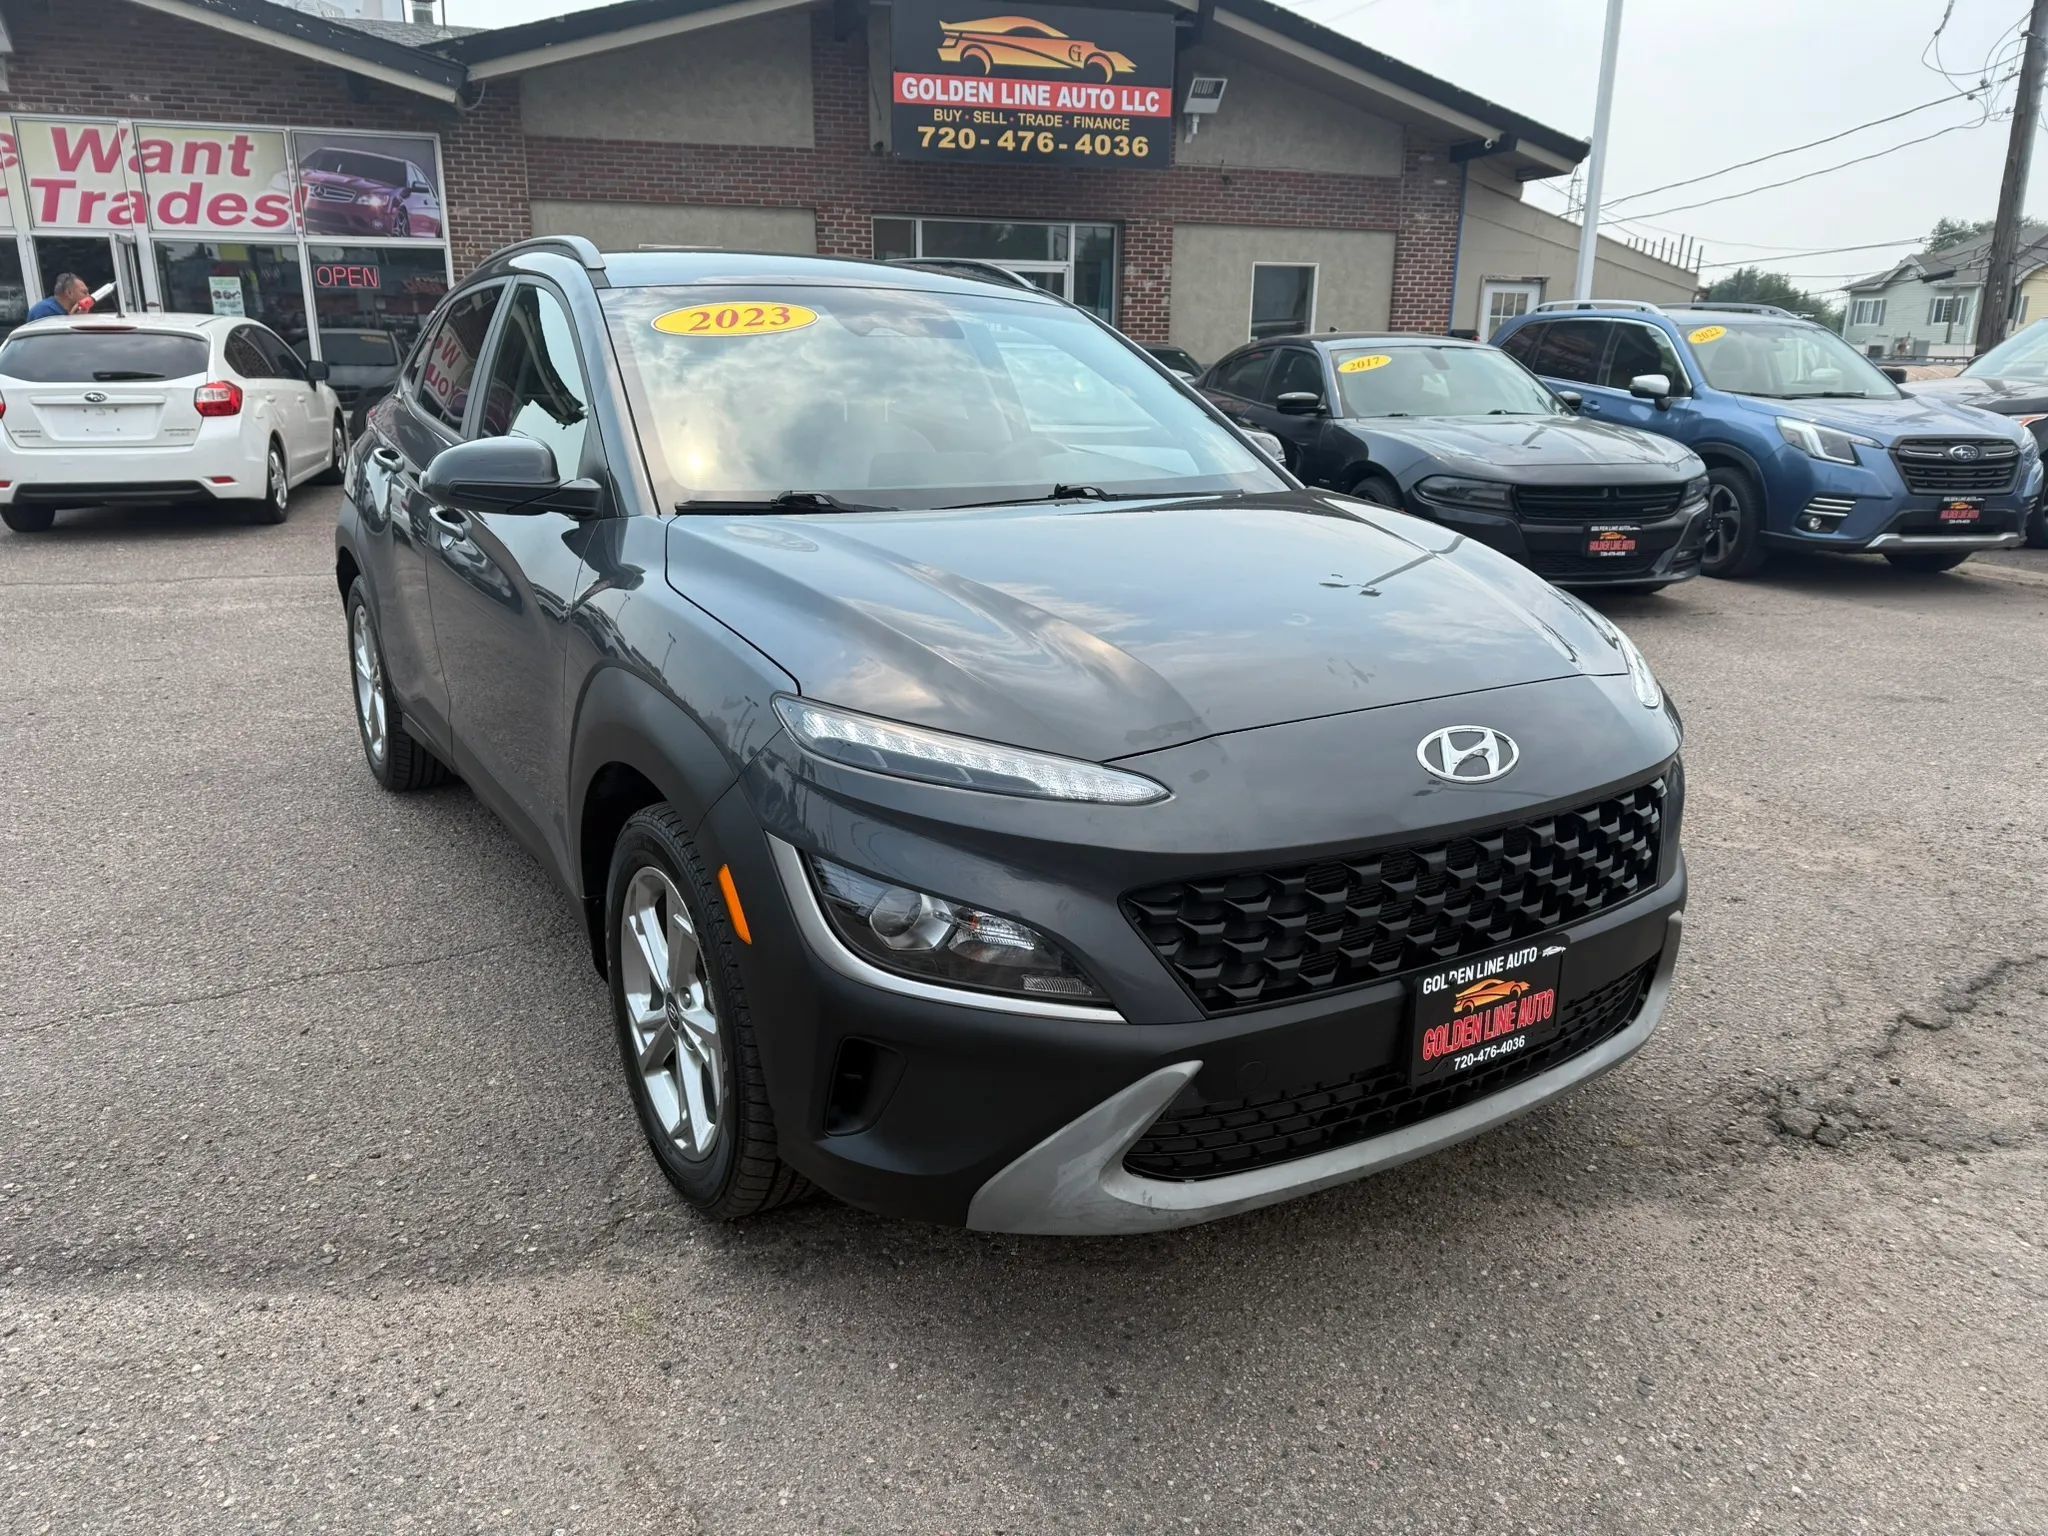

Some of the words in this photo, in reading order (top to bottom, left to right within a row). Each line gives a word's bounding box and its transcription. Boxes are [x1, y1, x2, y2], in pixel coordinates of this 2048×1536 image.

[1068, 44, 1082, 62] G
[902, 77, 994, 103] GOLDEN
[1001, 82, 1051, 107] LINE
[1057, 86, 1115, 110] AUTO
[1122, 90, 1160, 113] LLC
[934, 108, 962, 122] BUY
[973, 110, 1007, 124] SELL
[1018, 112, 1063, 128] TRADE
[1073, 115, 1130, 131] FINANCE
[51, 127, 254, 177] Want
[30, 178, 309, 228] Trades!
[316, 265, 379, 287] OPEN
[688, 306, 791, 332] 2023
[1350, 356, 1380, 371] 2017
[1422, 966, 1475, 995] GOLDEN
[1476, 956, 1505, 979] LINE
[1506, 946, 1538, 969] AUTO
[1422, 1011, 1482, 1061] GOLDEN
[1484, 1001, 1517, 1040] LINE
[1517, 988, 1555, 1030] AUTO
[1453, 1035, 1526, 1071] 720-476-4036
